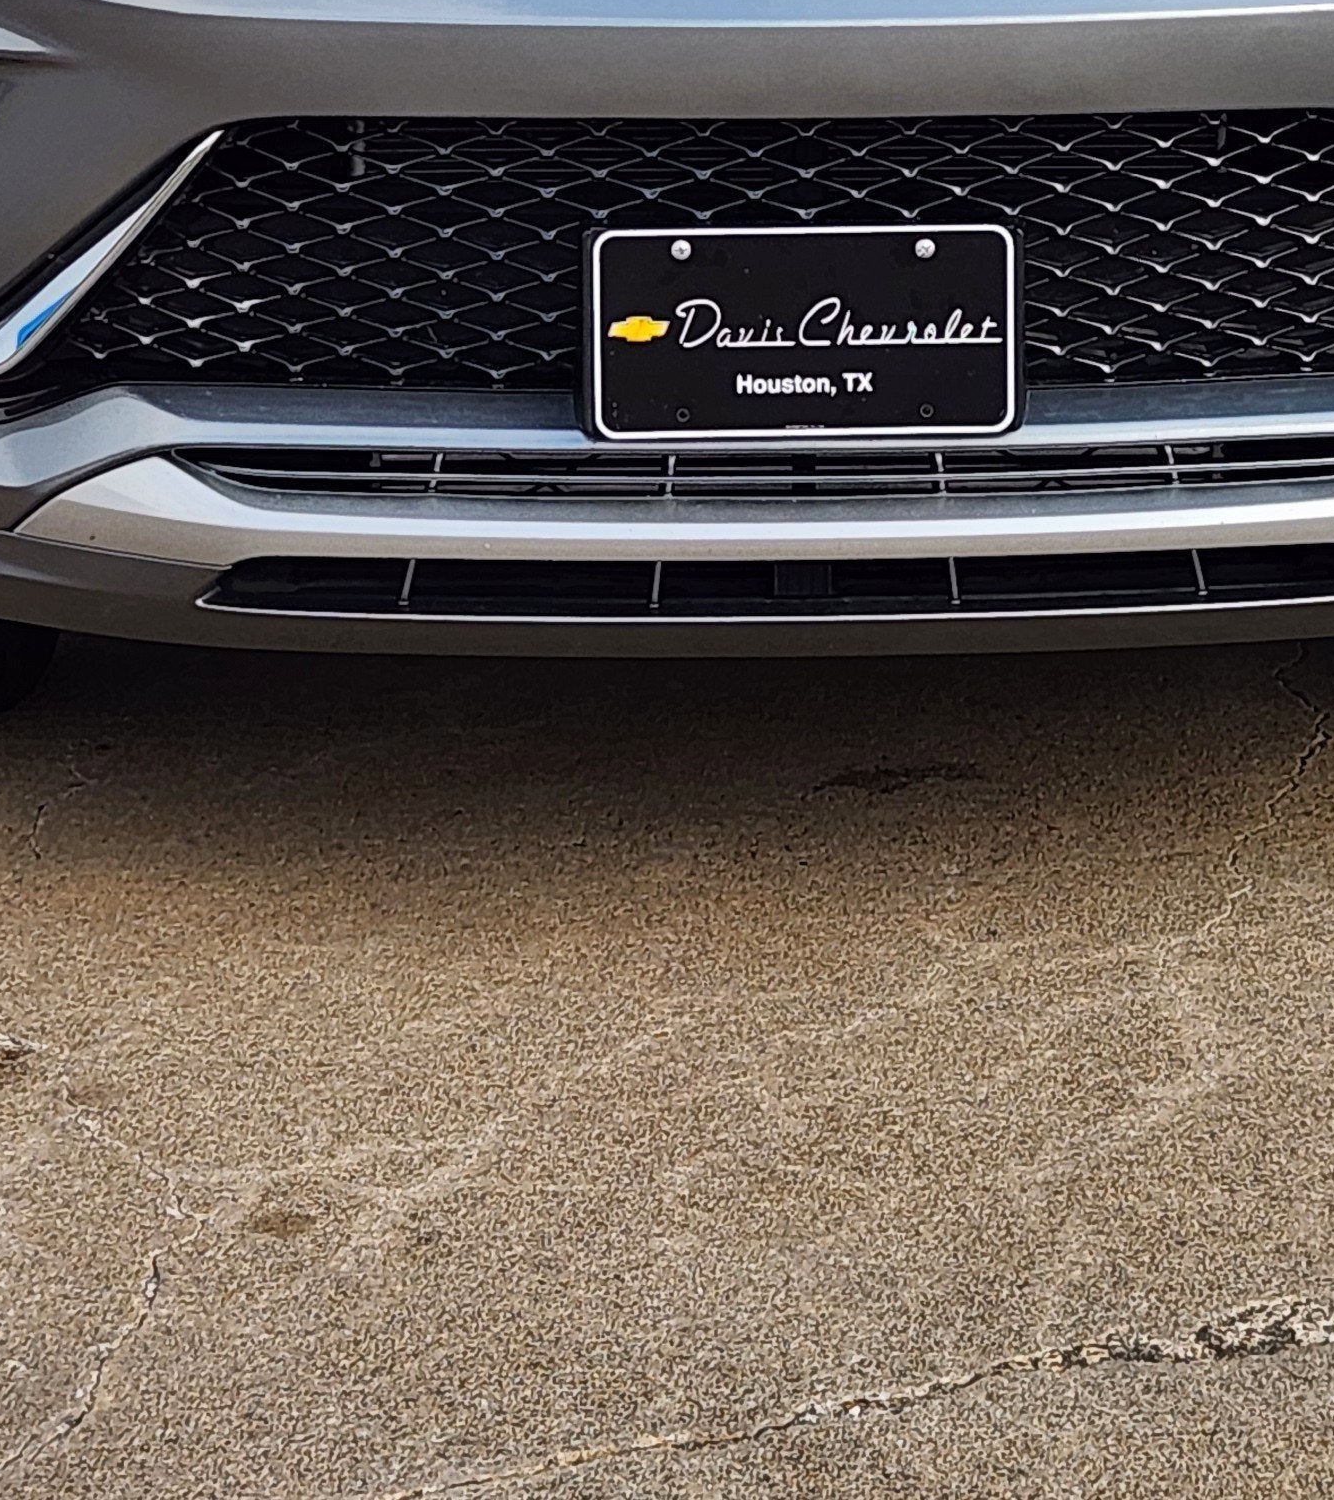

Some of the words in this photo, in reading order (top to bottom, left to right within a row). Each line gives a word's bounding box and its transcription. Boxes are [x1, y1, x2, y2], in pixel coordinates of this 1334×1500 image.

[675, 298, 796, 348] Davis
[798, 297, 1003, 347] Chevrolet
[736, 372, 837, 397] Houston,
[842, 372, 874, 393] TX
